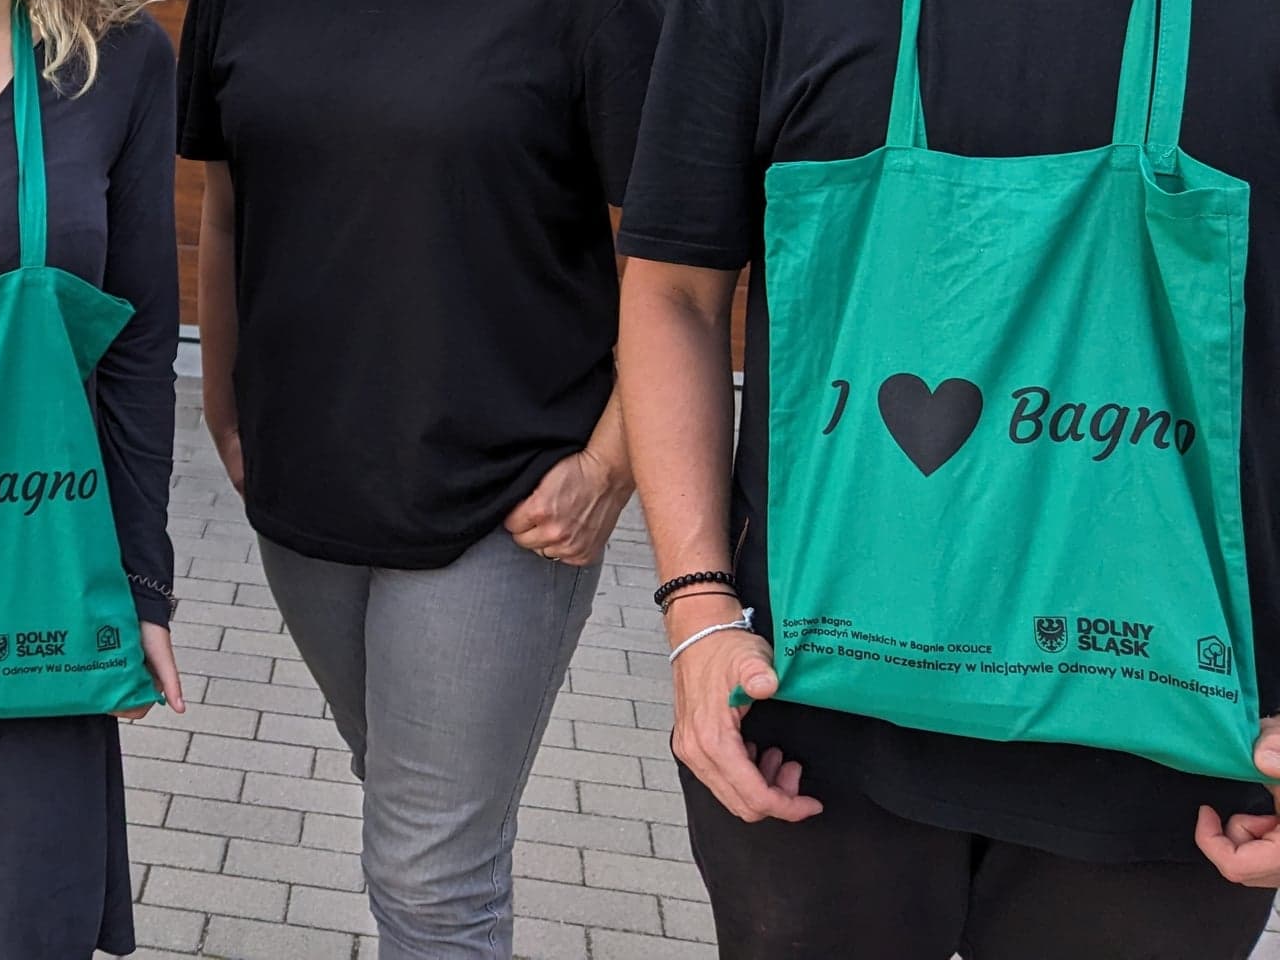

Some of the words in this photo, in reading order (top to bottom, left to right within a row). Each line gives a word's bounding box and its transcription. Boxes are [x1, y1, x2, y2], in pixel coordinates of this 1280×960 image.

[1009, 386, 1196, 462] Bagno
[16, 630, 68, 645] DOLNY
[1076, 617, 1154, 640] DOLNY
[850, 630, 897, 646] Wiejskich
[898, 640, 908, 648] w
[910, 641, 945, 654] Bagnie
[947, 643, 993, 654] OKOLICE
[2, 665, 44, 677] Odnowy
[837, 644, 881, 661] Bagno
[884, 654, 961, 674] uczestniczy
[965, 663, 977, 672] w
[1057, 662, 1117, 679] Odnowy
[1120, 666, 1145, 681] Wsi
[1148, 671, 1240, 704] Dolnośląskiej
